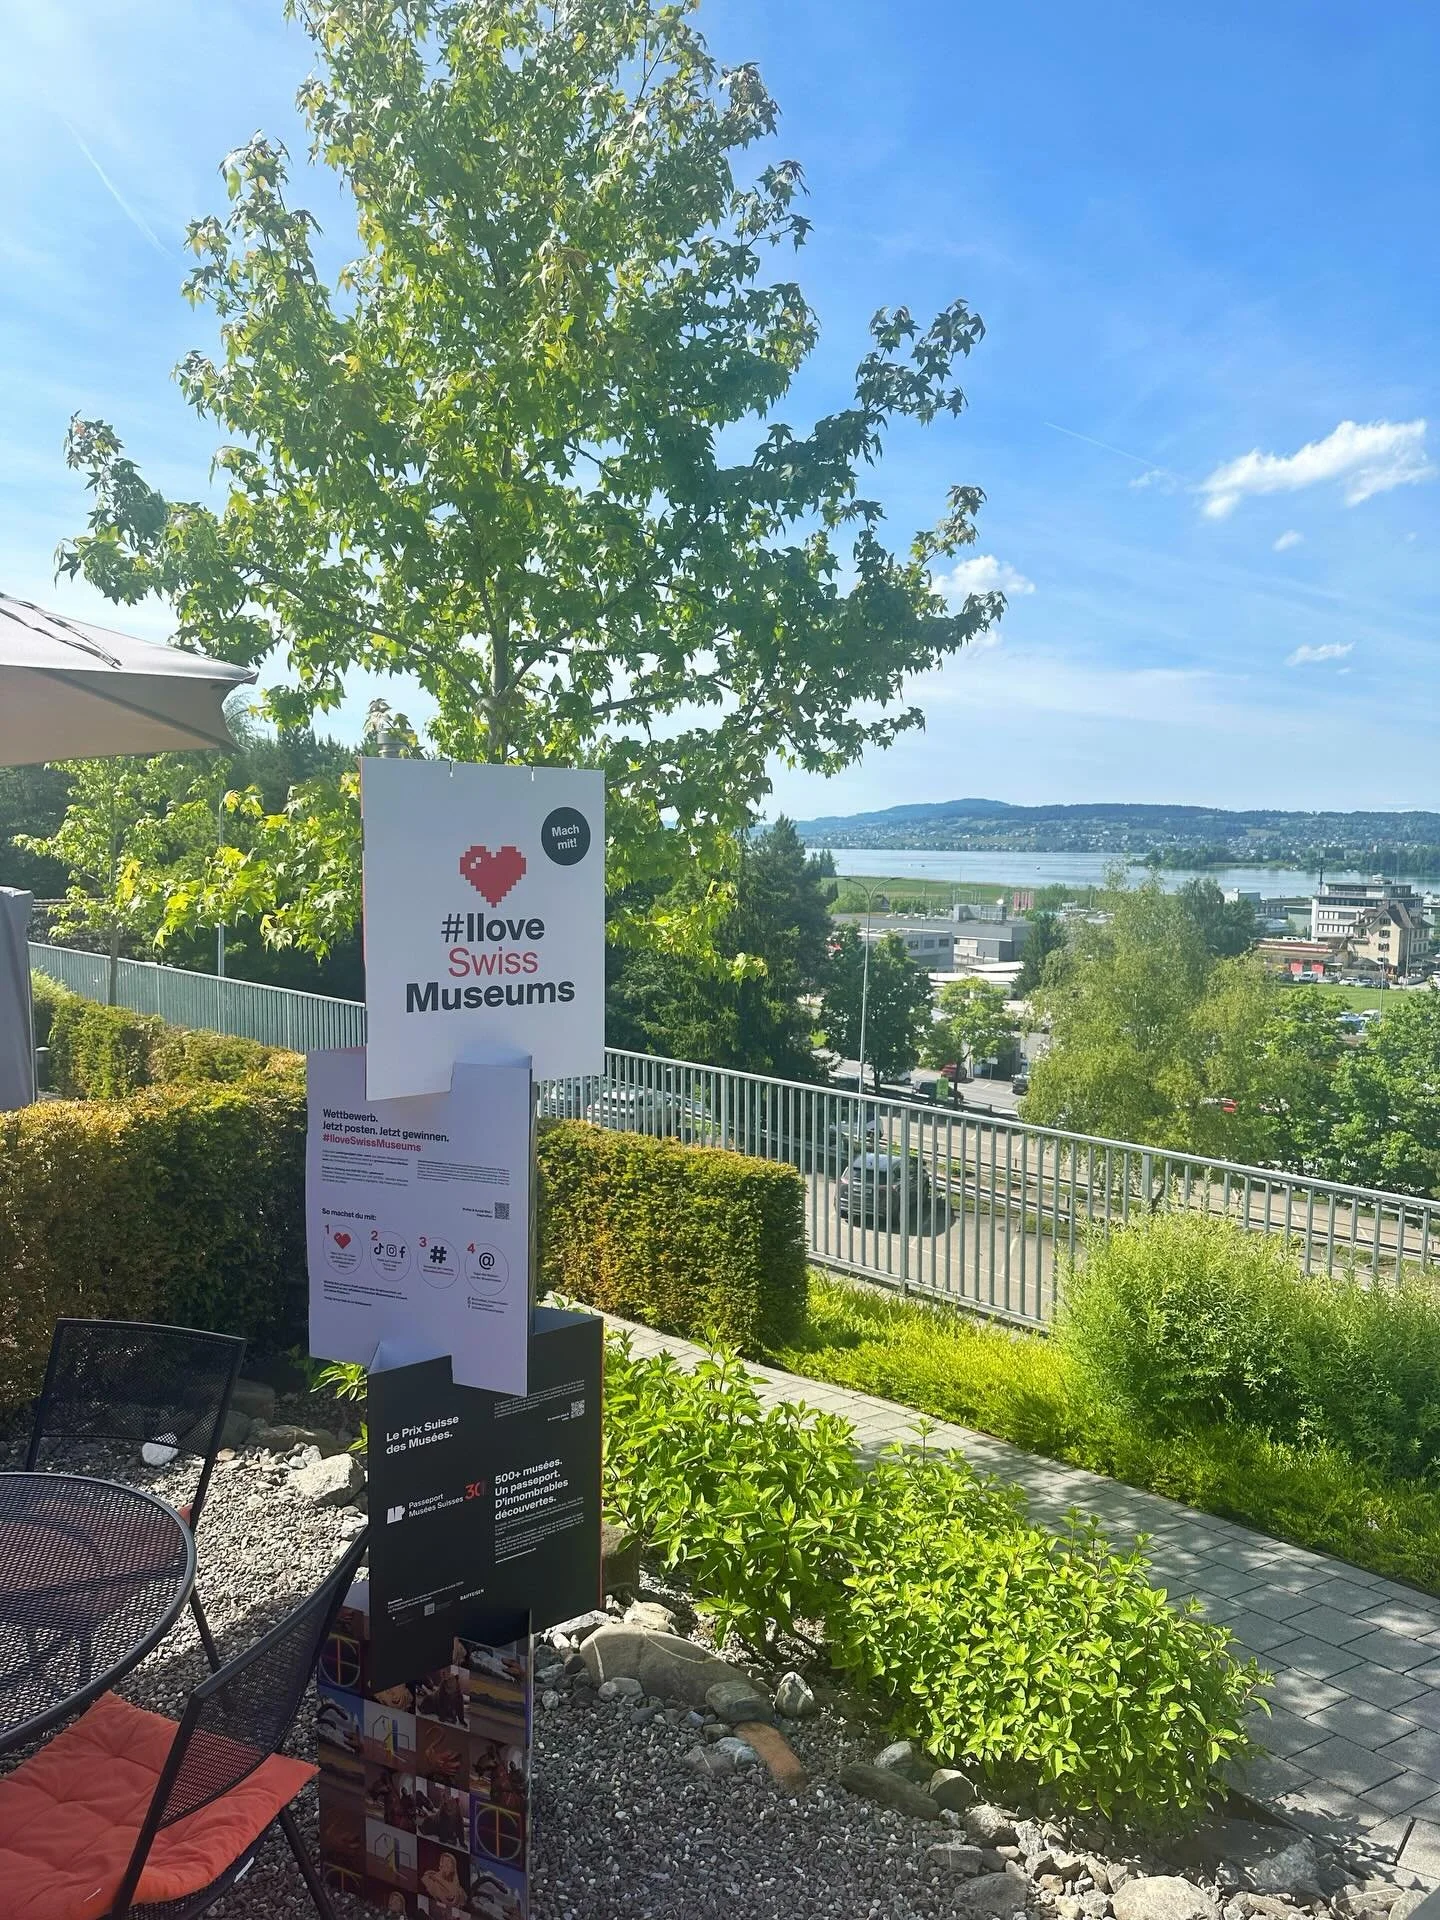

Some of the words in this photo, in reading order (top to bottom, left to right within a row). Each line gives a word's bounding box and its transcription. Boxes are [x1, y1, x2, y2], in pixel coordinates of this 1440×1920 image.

[552, 824, 580, 837] Mach
[557, 838, 577, 850] mit!
[441, 912, 545, 943] #Ilove
[448, 946, 538, 978] Swiss
[406, 980, 575, 1013] Museums
[322, 1108, 378, 1123] Wettbewerb.
[322, 1121, 343, 1132] Jetzt
[344, 1124, 378, 1136] posten.
[379, 1127, 401, 1138] Jetzt
[402, 1129, 450, 1143] gewinnen.
[322, 1133, 422, 1152] #IloveSwissMuseums
[321, 1207, 330, 1215] So
[331, 1208, 355, 1219] machst
[356, 1212, 363, 1220] du
[363, 1212, 377, 1221] mit:
[324, 1224, 330, 1234] 1
[371, 1230, 378, 1241] 2
[419, 1236, 427, 1248] 3
[467, 1243, 475, 1254] 4
[385, 1431, 400, 1443] Le
[402, 1422, 422, 1438] Prix
[424, 1413, 459, 1432] Suisse
[385, 1441, 406, 1455] des
[408, 1429, 453, 1449] Musées.
[495, 1468, 521, 1484] 500+
[523, 1457, 563, 1475] musées.
[495, 1484, 509, 1496] Un
[510, 1471, 561, 1494] passeport.
[495, 1478, 569, 1508] D'innombrables
[408, 1493, 444, 1509] Passeport
[408, 1504, 437, 1518] Musées
[437, 1496, 464, 1511] Suisses
[495, 1495, 557, 1520] découvertes.
